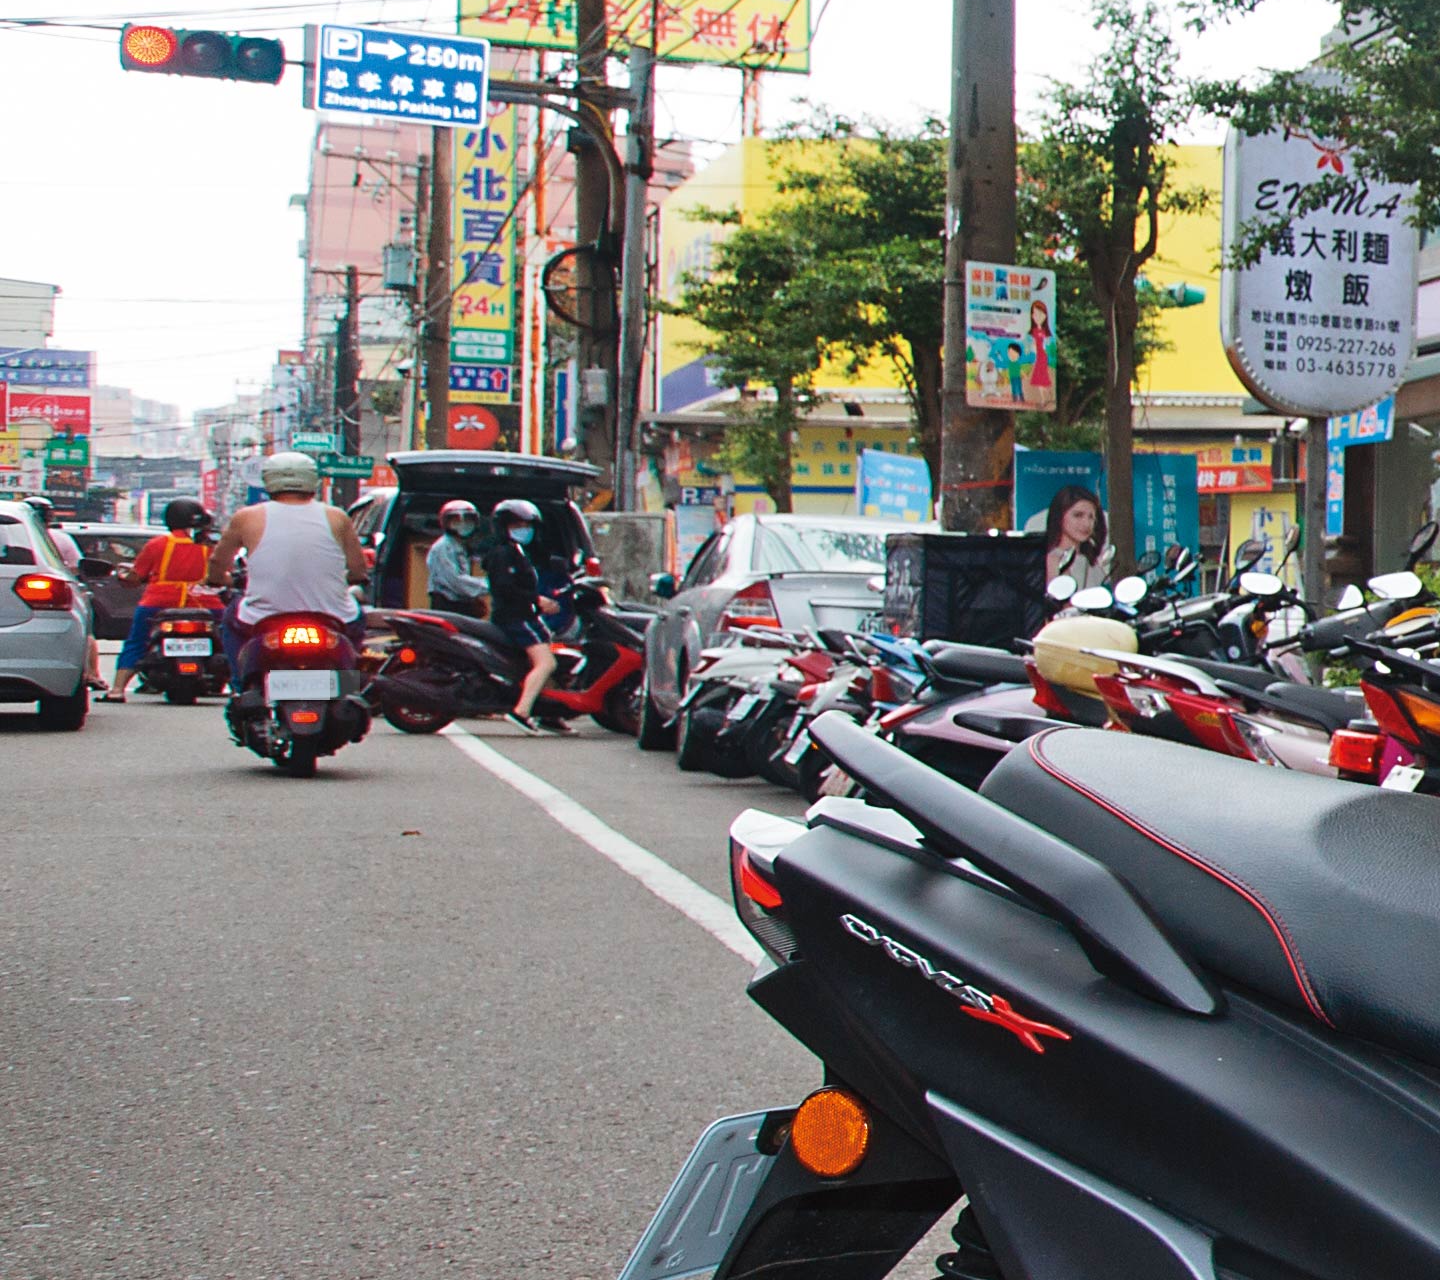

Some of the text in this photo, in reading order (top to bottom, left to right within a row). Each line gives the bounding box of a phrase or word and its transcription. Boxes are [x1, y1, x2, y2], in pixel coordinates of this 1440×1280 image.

[330, 30, 483, 72] P 250m
[399, 100, 452, 119] Parking
[453, 106, 478, 120] Lot
[462, 125, 506, 287] 小北百貨
[1269, 226, 1390, 265] 義大利麵
[458, 295, 504, 317] 24H
[1296, 335, 1396, 357] 0925-227-266
[1296, 358, 1397, 379] 03-4635778
